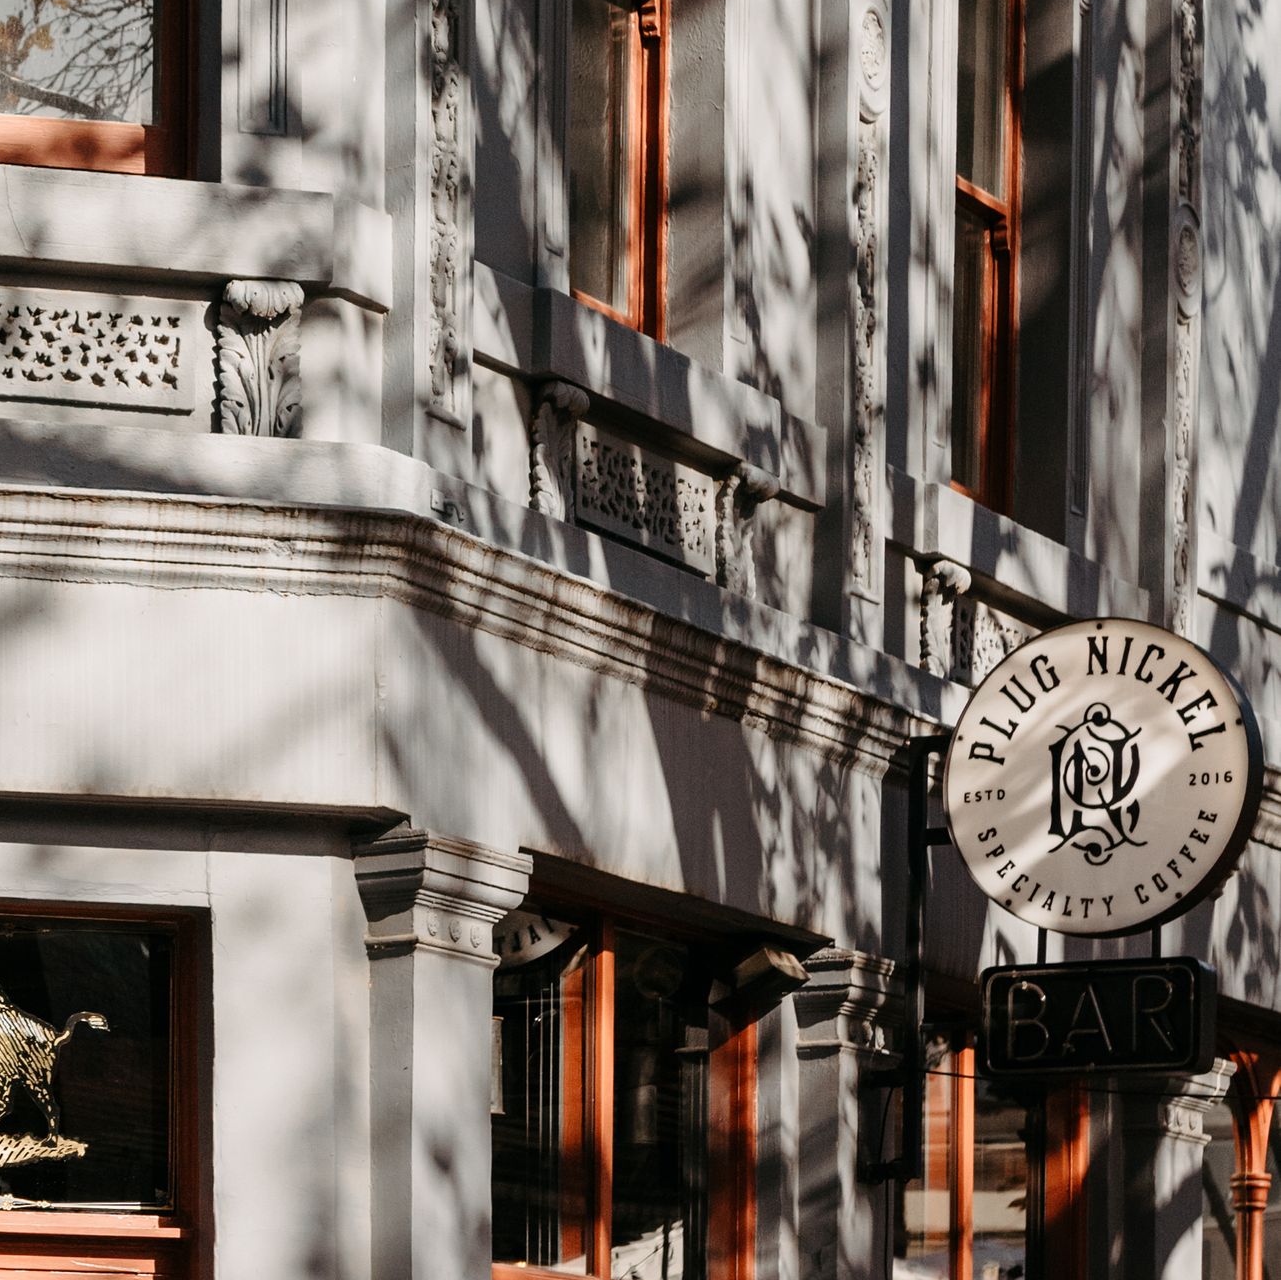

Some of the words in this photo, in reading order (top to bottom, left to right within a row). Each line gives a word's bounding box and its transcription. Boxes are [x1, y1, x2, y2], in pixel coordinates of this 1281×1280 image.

[968, 654, 1060, 766] PLUG
[1086, 636, 1226, 752] NICKEL
[963, 789, 1006, 803] ESTD
[1188, 771, 1233, 785] 2016
[978, 827, 1114, 919] SPECIALTY
[1134, 809, 1218, 904] COFFEE
[1007, 976, 1175, 1061] BAR
